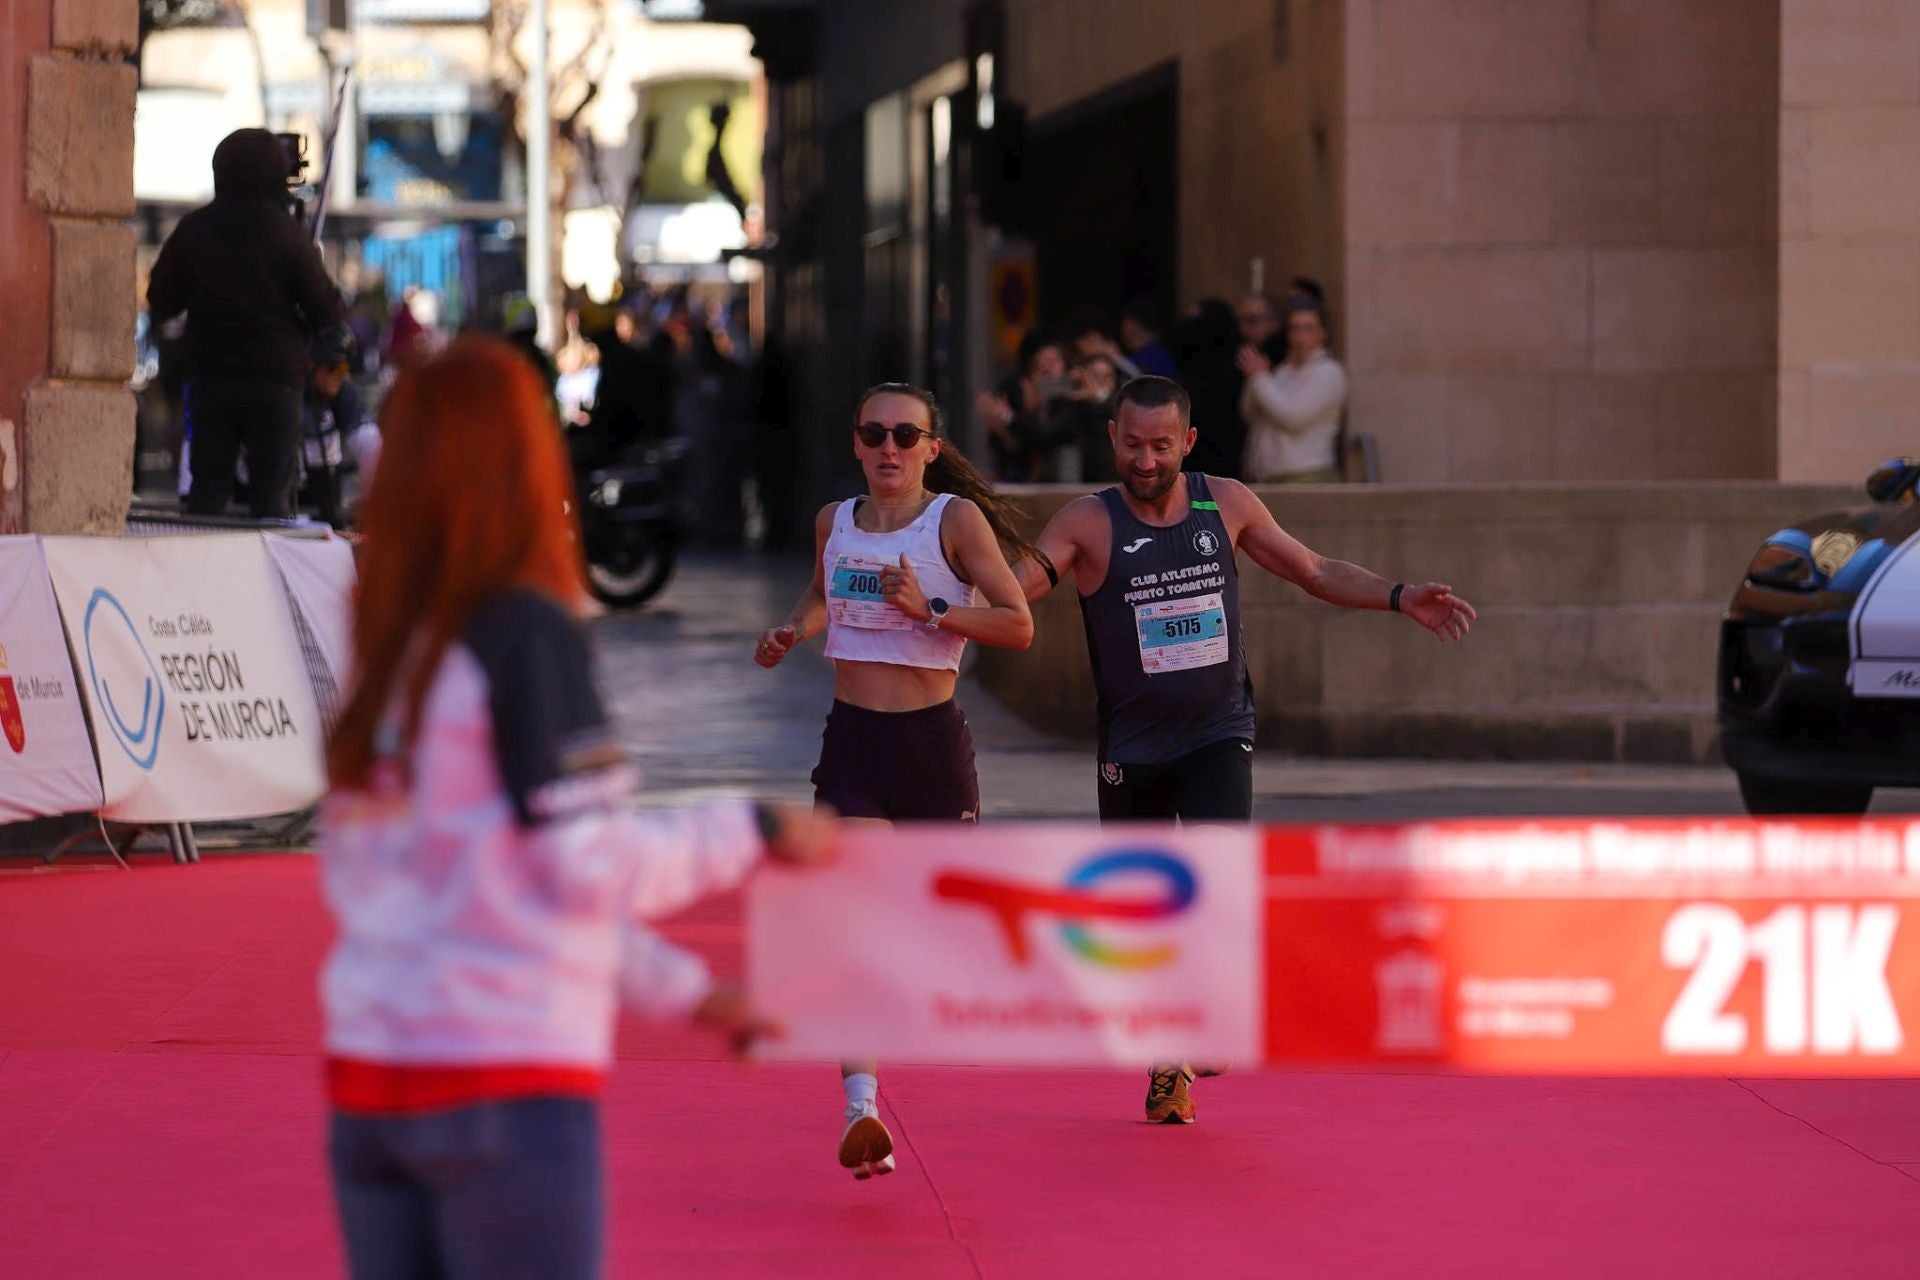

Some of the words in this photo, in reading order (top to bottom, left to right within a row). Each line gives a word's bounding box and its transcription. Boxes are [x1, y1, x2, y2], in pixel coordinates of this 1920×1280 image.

[1130, 574, 1158, 587] CLUB
[1161, 561, 1220, 582] ATLETISMO
[1124, 587, 1165, 603] PUERTO
[148, 615, 177, 638] Costa
[1165, 617, 1201, 638] 5175
[161, 645, 246, 693] REGIÓN
[180, 701, 212, 743] DE
[206, 696, 298, 742] MURCIA
[1661, 901, 1904, 1056] 21K
